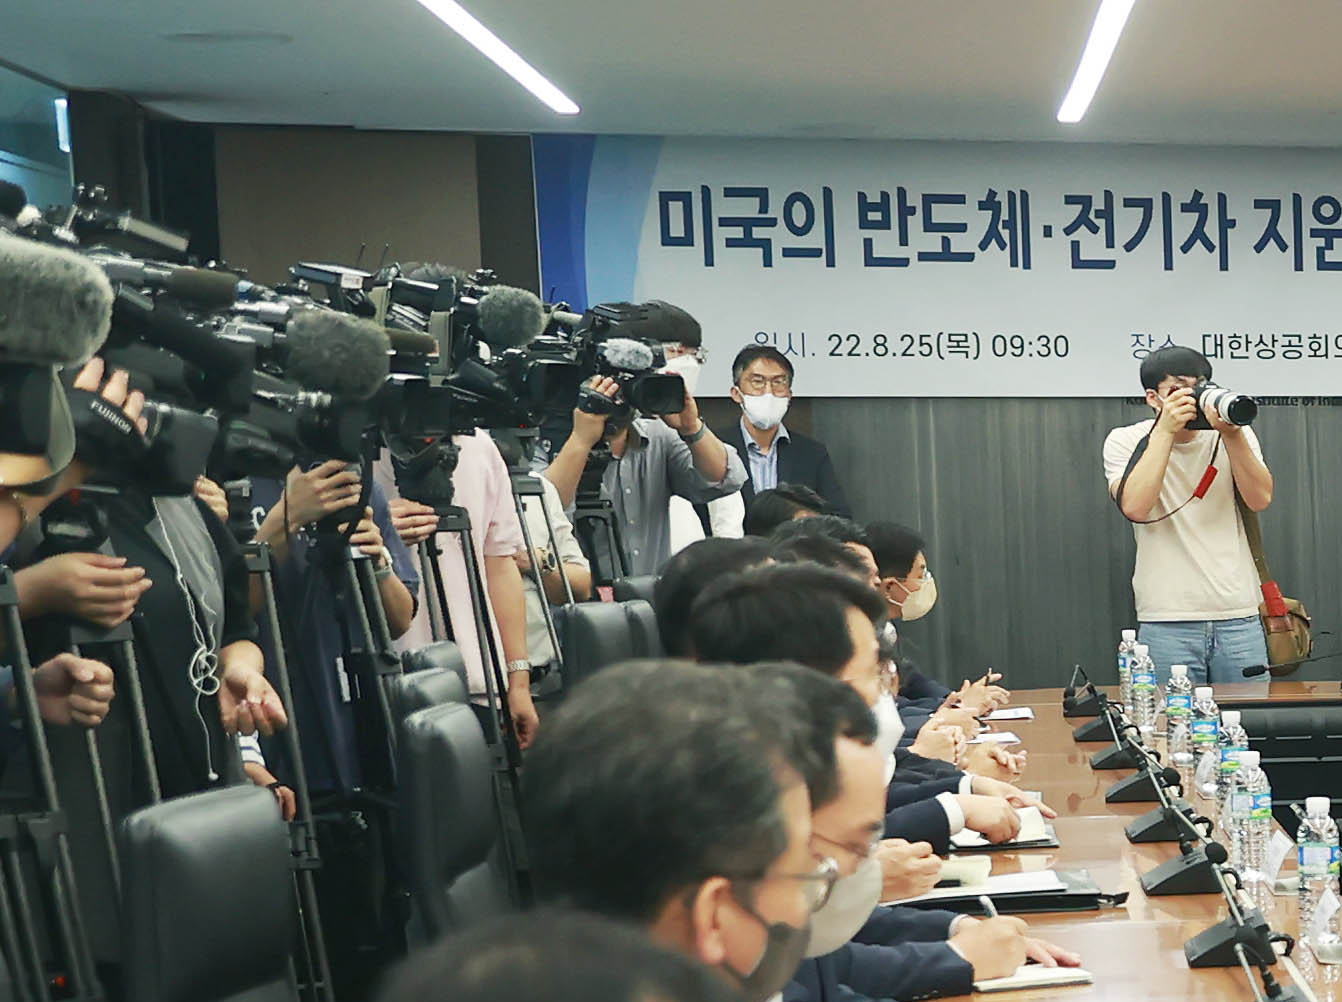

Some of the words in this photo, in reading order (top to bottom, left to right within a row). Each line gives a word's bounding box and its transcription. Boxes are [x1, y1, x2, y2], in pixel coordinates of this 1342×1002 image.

[658, 185, 837, 268] 미국의
[857, 187, 1236, 272] 반도체·전기차
[827, 331, 980, 361] 22.8.25(목)
[991, 334, 1069, 358] 09:30
[91, 400, 132, 433] FUJINON
